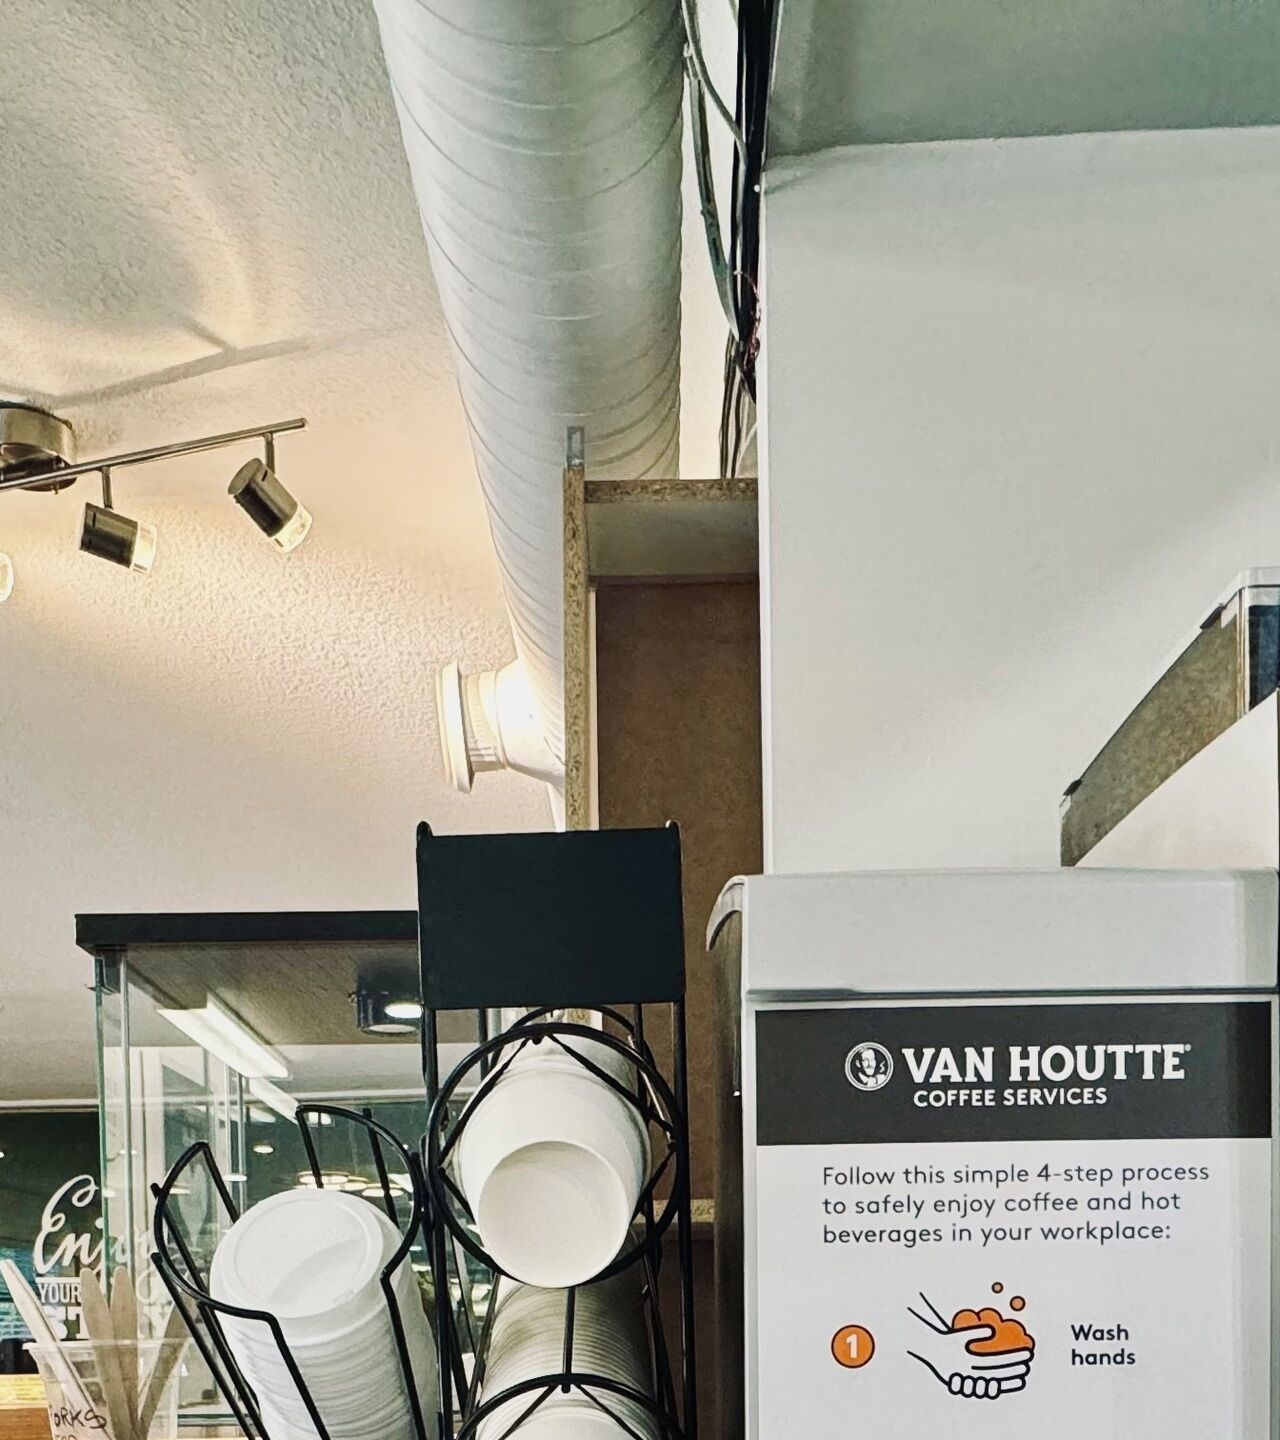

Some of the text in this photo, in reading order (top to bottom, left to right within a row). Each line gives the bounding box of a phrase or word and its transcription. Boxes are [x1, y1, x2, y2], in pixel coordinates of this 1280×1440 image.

[902, 1044, 1188, 1083] VAN HOUTTE
[914, 1088, 1107, 1107] COFFEE SERVICES
[824, 1164, 1209, 1188] Follow this simple 4-step process
[823, 1191, 1180, 1218] to safely enjoy coffee and hot
[824, 1221, 1170, 1248] beverages in your workplace:
[38, 1283, 82, 1303] YOUR
[1071, 1324, 1128, 1341] Wash
[1072, 1348, 1135, 1365] hands
[48, 1406, 107, 1429] ORKS
